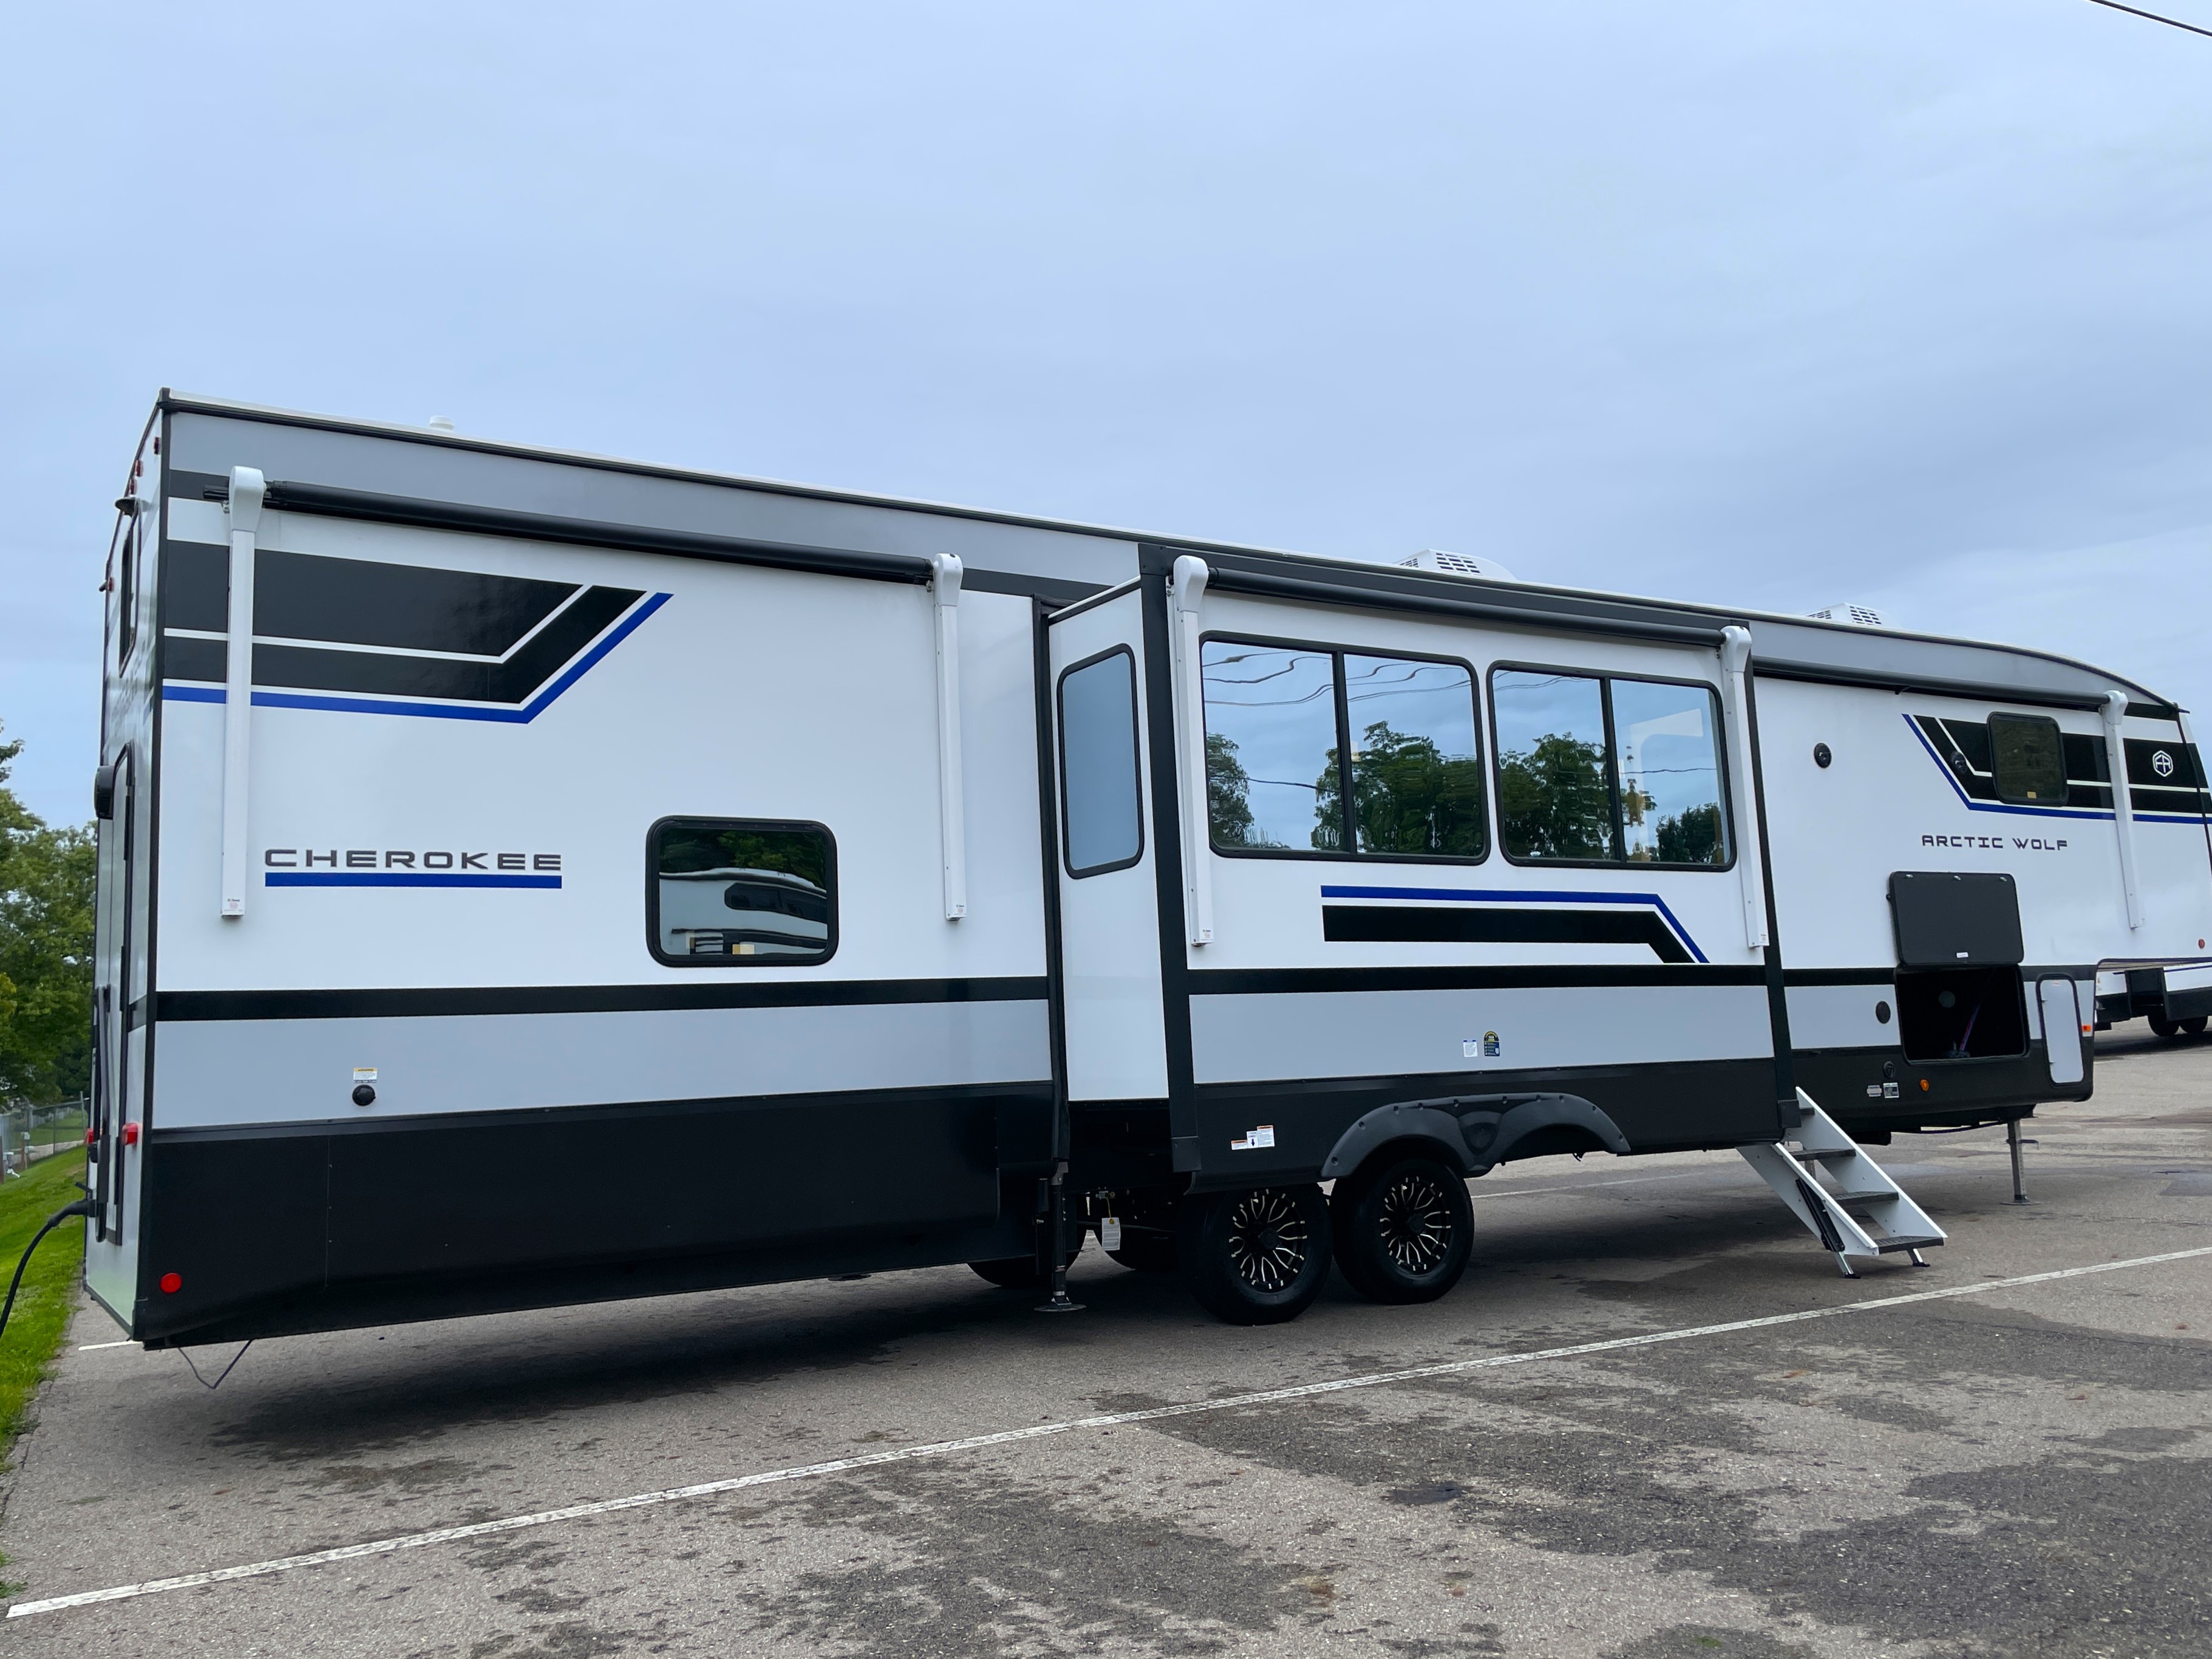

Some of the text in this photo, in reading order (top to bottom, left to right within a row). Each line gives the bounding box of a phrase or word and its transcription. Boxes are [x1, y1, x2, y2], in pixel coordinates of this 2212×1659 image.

[1921, 834, 2068, 851] ARCTIC WOLF
[265, 848, 562, 871] CHEROKEE
